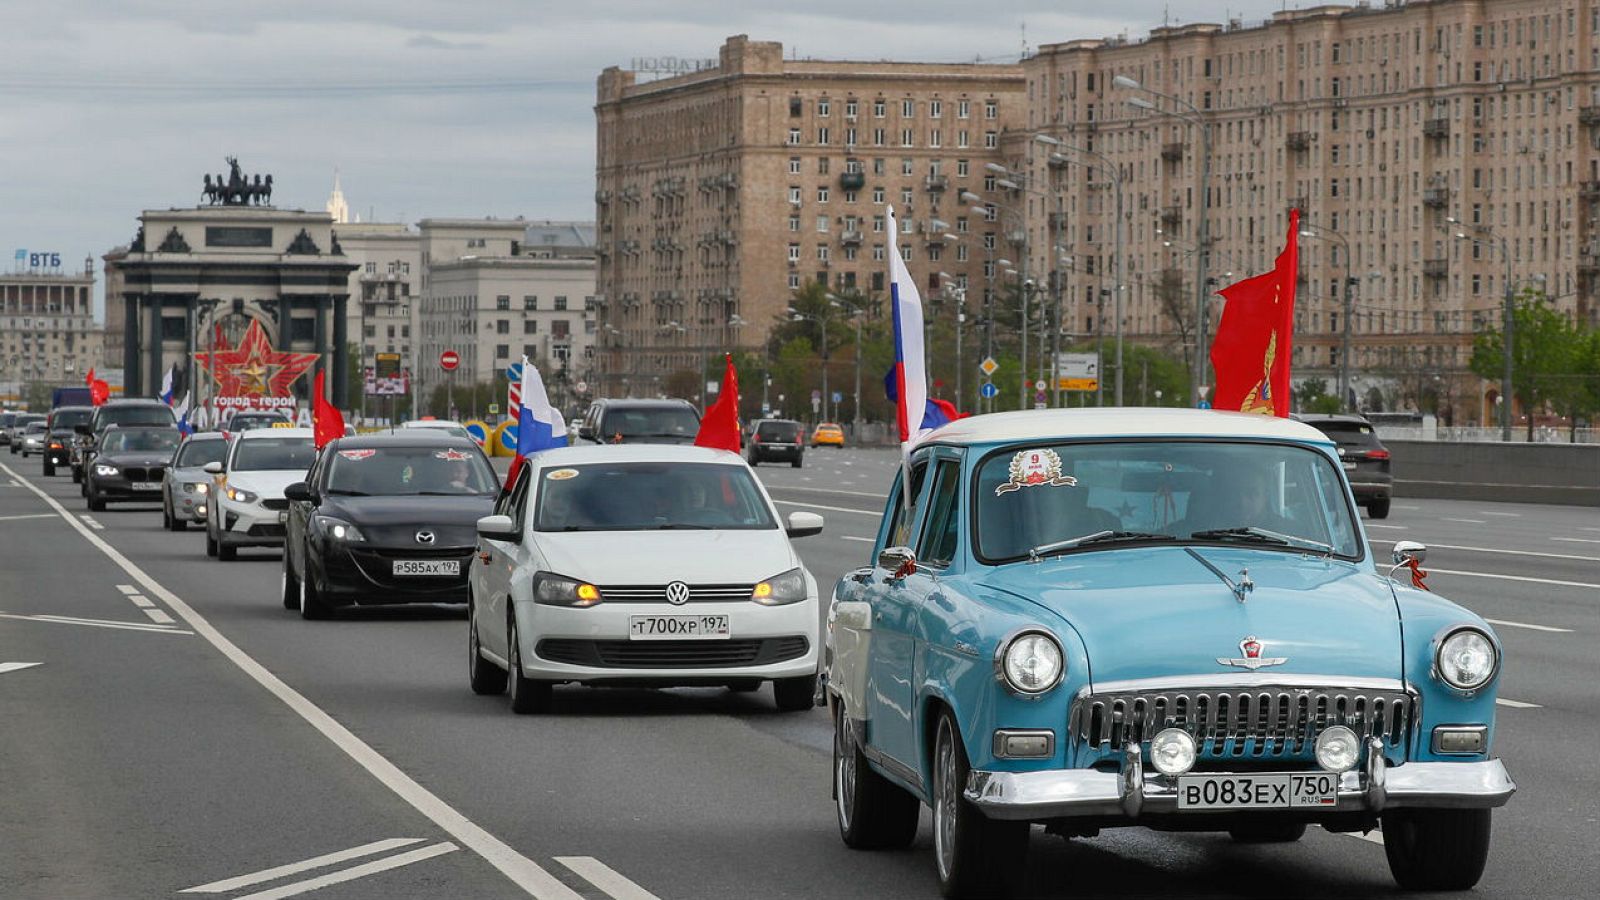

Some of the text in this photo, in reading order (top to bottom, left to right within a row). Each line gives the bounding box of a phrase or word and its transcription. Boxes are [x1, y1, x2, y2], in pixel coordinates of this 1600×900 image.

[30, 253, 61, 267] ВТБ
[1031, 454, 1040, 464] 9
[701, 617, 724, 629] 197
[1292, 776, 1330, 796] 750
[1301, 796, 1320, 804] RUS
